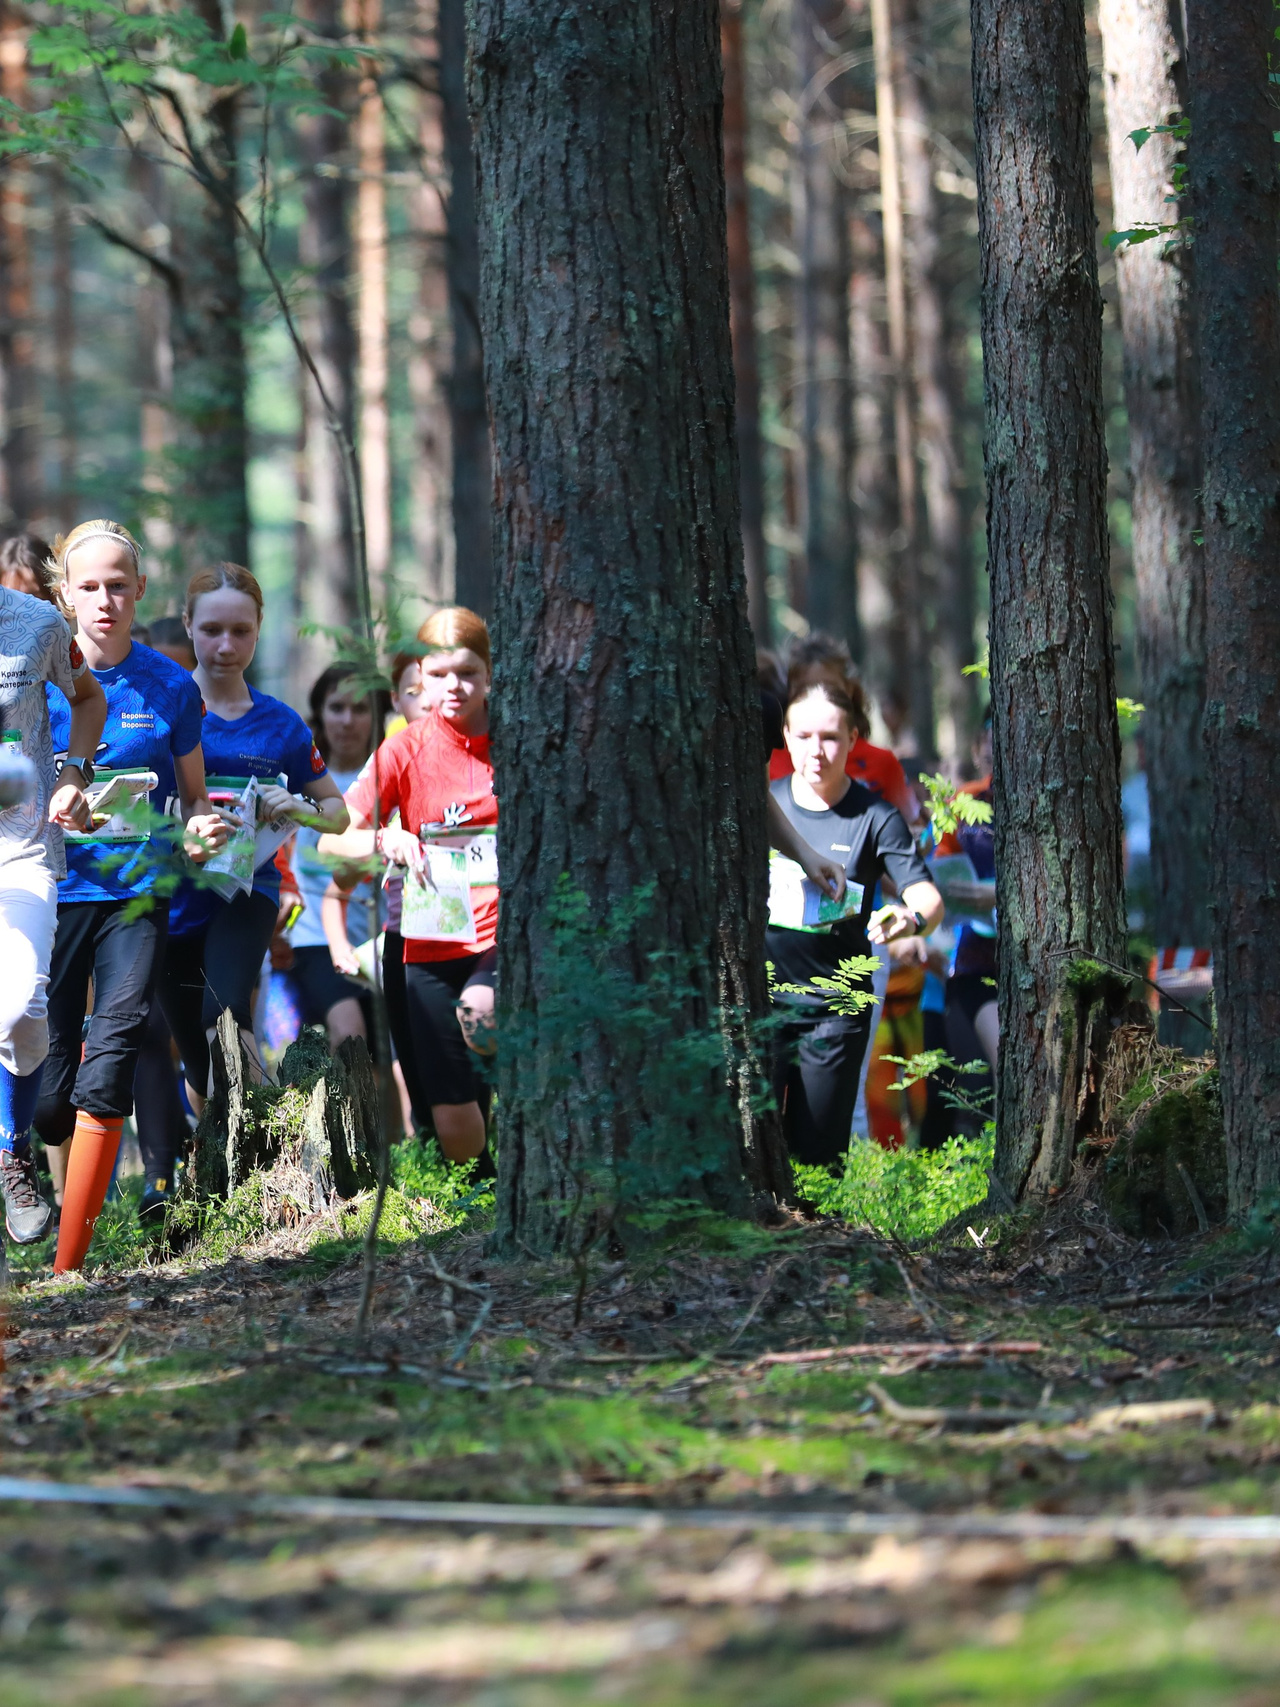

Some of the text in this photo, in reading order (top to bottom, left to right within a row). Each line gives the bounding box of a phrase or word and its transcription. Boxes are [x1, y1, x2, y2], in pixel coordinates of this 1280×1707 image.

[0, 670, 27, 679] Краузе
[121, 712, 154, 721] Вероника
[470, 845, 483, 863] 8
